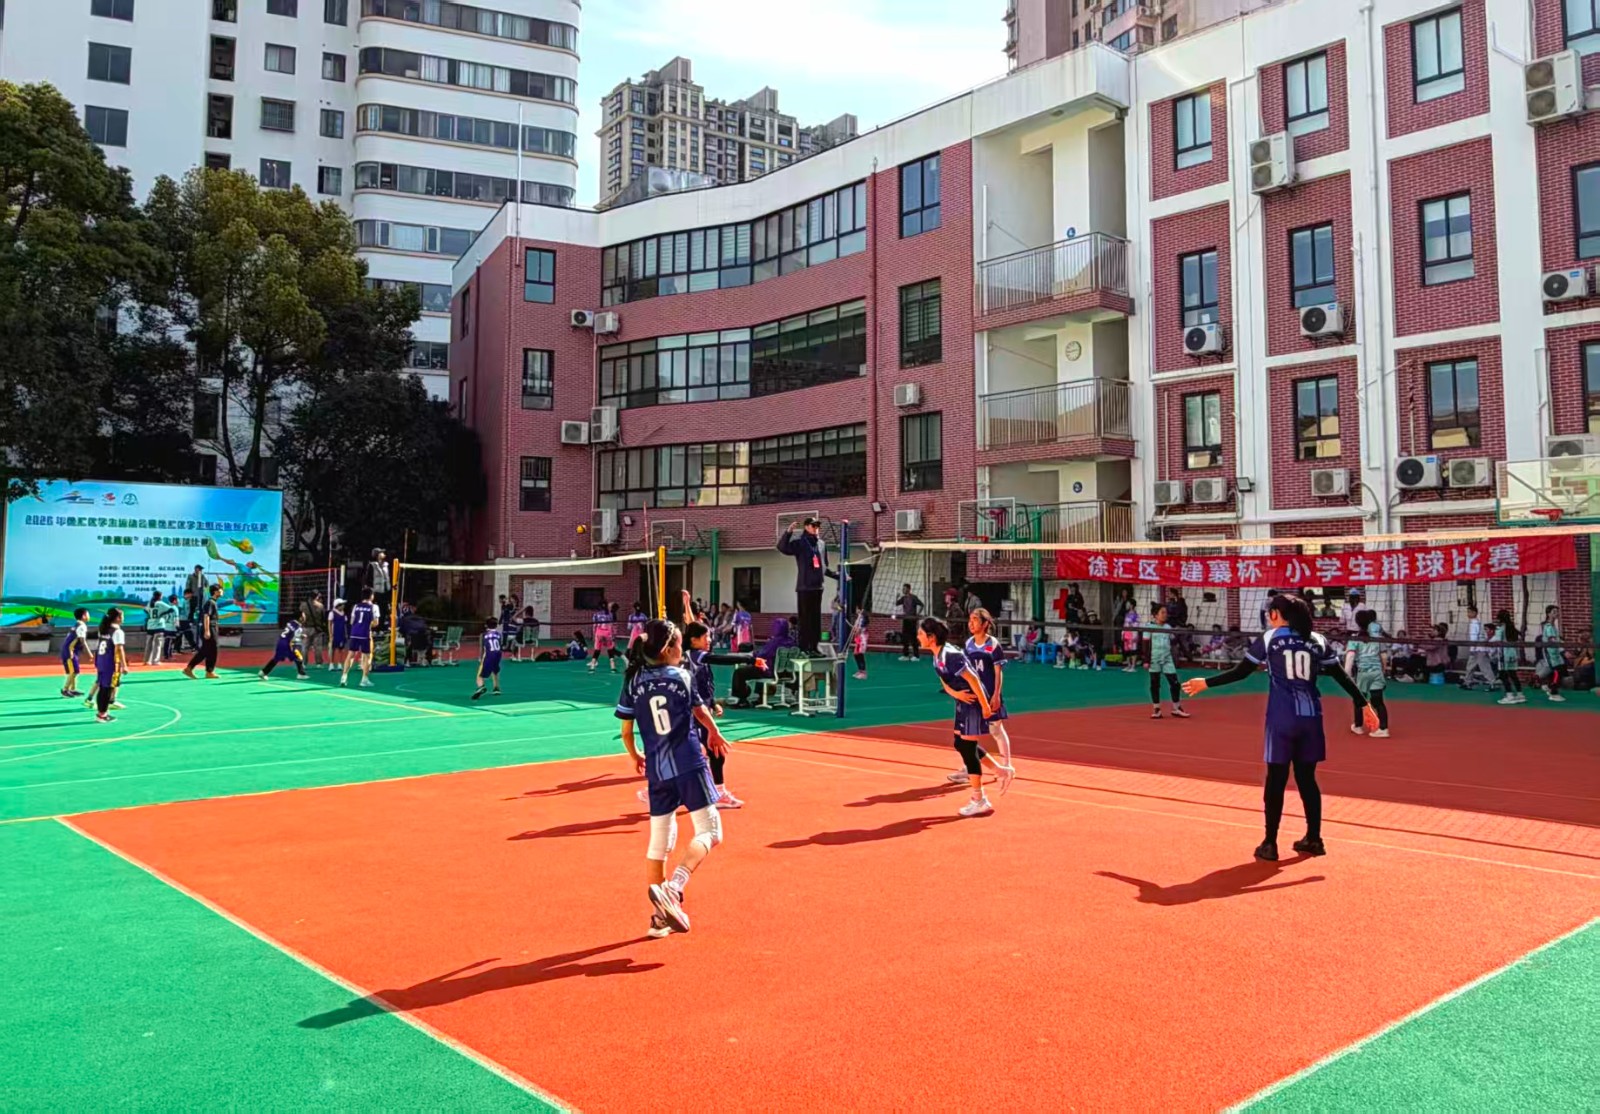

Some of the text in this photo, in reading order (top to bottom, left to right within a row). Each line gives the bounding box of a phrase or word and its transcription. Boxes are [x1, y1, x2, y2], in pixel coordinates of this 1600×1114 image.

[280, 627, 290, 638] 2
[488, 639, 500, 651] 10
[1282, 649, 1311, 681] 10
[649, 695, 672, 735] 6
